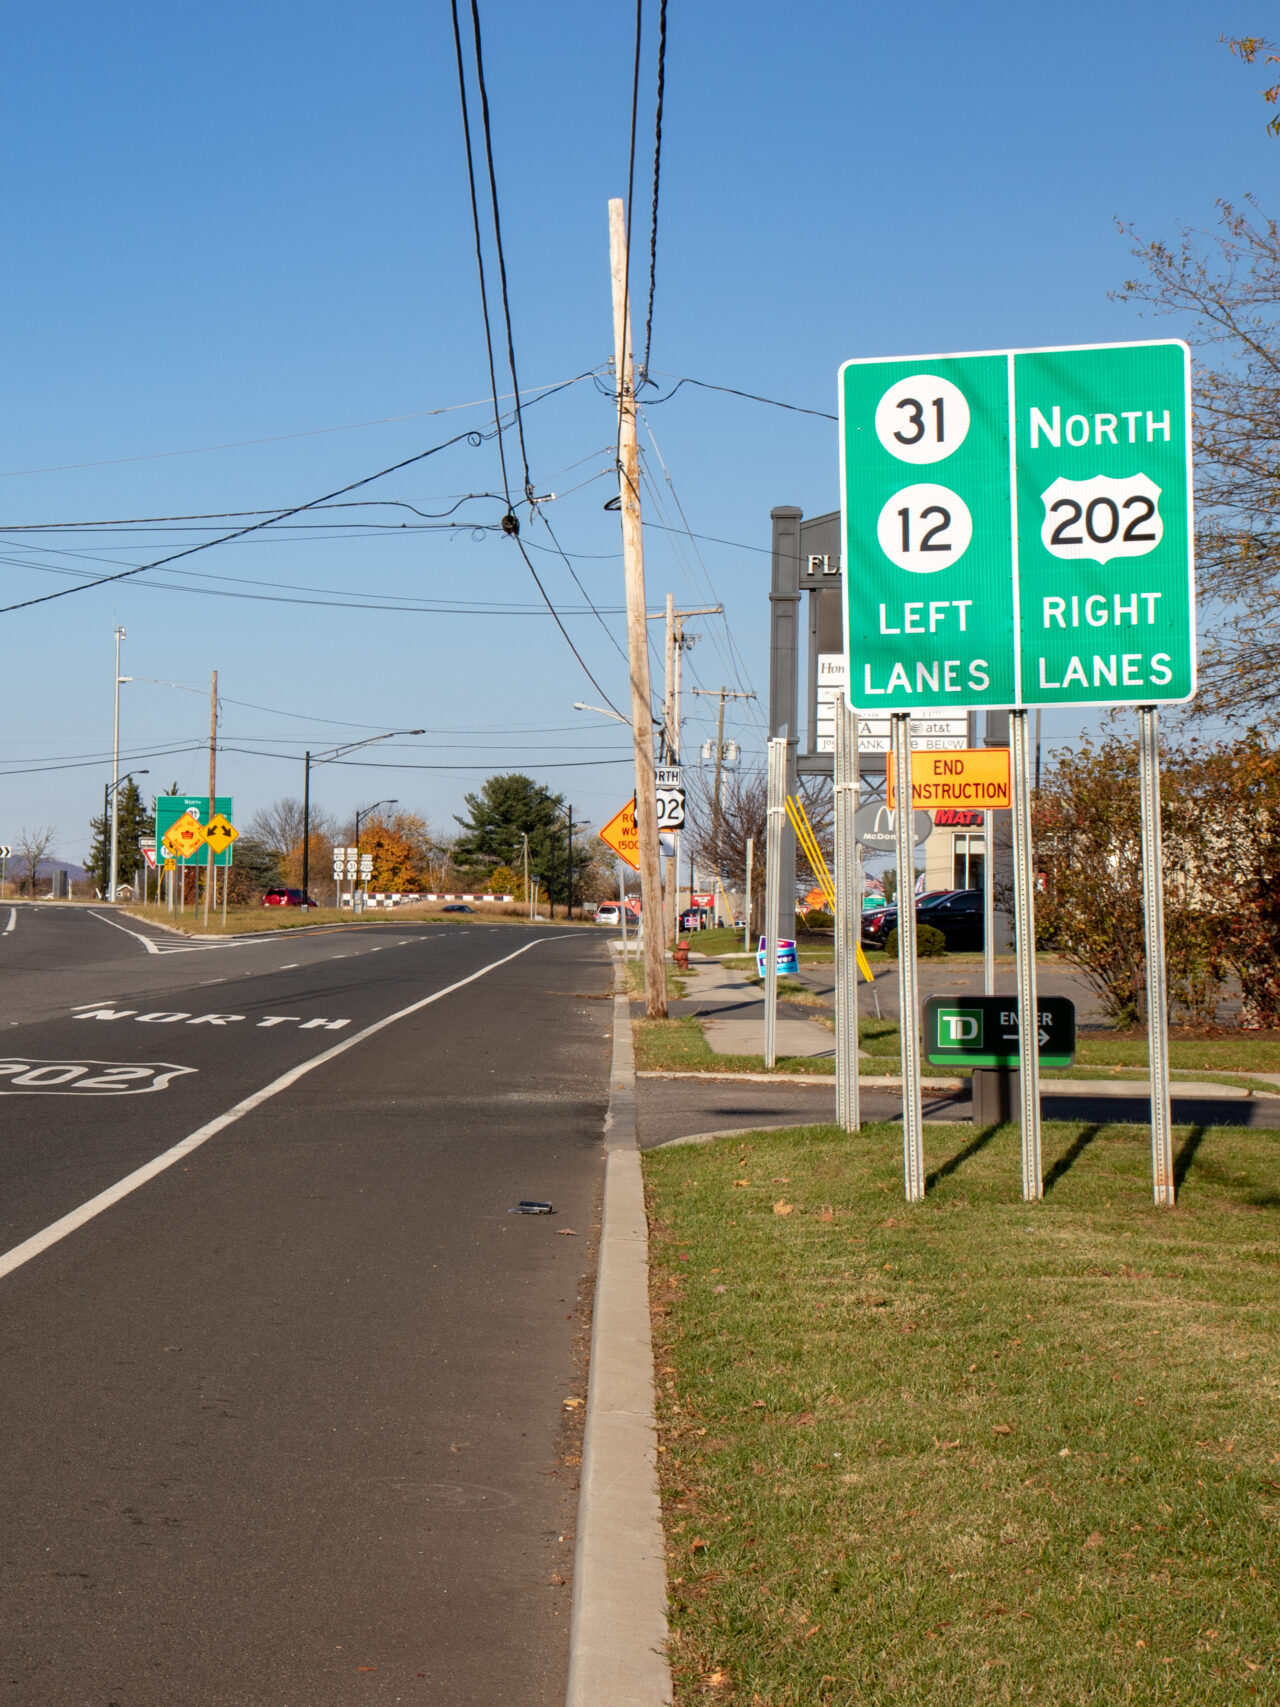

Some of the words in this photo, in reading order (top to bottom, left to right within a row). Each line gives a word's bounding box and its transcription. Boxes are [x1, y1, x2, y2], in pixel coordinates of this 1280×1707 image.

[892, 397, 945, 445] 31
[1029, 405, 1171, 449] NORTH
[897, 505, 952, 553] 12
[1049, 495, 1157, 545] 202
[879, 600, 973, 635] LEFT
[1042, 592, 1162, 629] RIGHT
[864, 659, 991, 695] LANES
[1038, 652, 1173, 689] LANES
[925, 722, 950, 733] at&t
[858, 740, 884, 750] ANK
[655, 770, 679, 782] RTH
[933, 759, 965, 775] END
[892, 782, 1007, 799] NSTRUCTION
[657, 798, 680, 820] 02
[863, 833, 919, 841] McDons
[71, 1009, 352, 1031] NORTH
[942, 1015, 978, 1040] TD
[999, 1011, 1053, 1027] ENER
